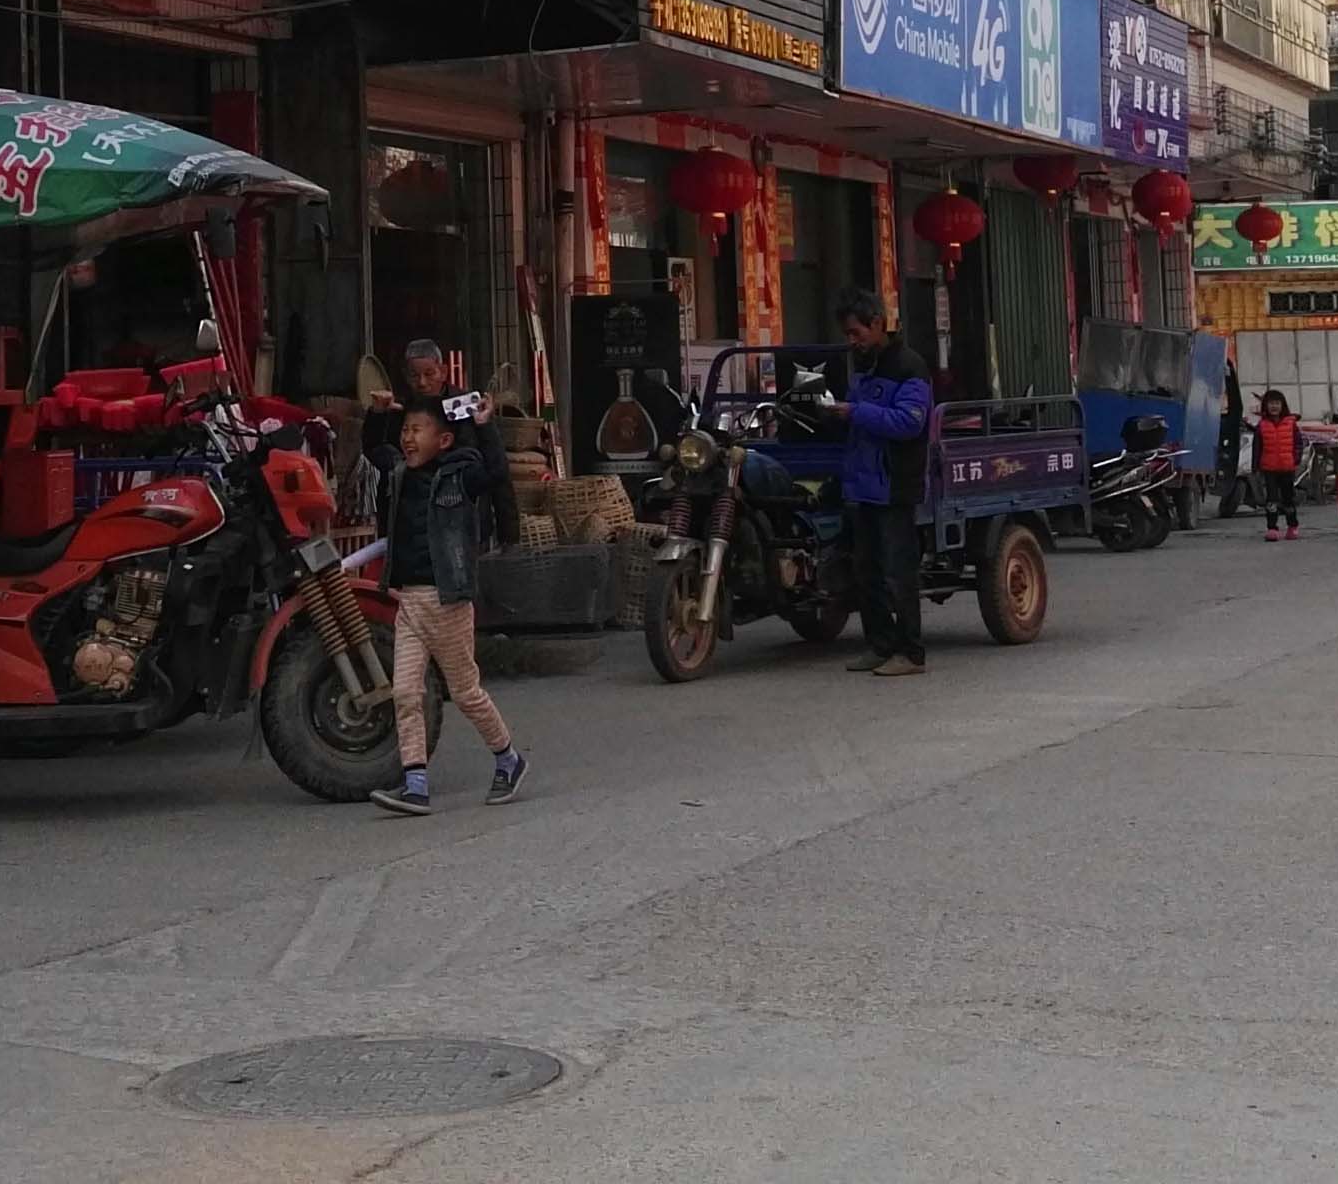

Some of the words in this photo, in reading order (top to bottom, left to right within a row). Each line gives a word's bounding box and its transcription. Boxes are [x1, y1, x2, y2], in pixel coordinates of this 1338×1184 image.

[895, 16, 926, 58] China
[927, 27, 960, 68] Mobile
[953, 461, 983, 483] 江苏
